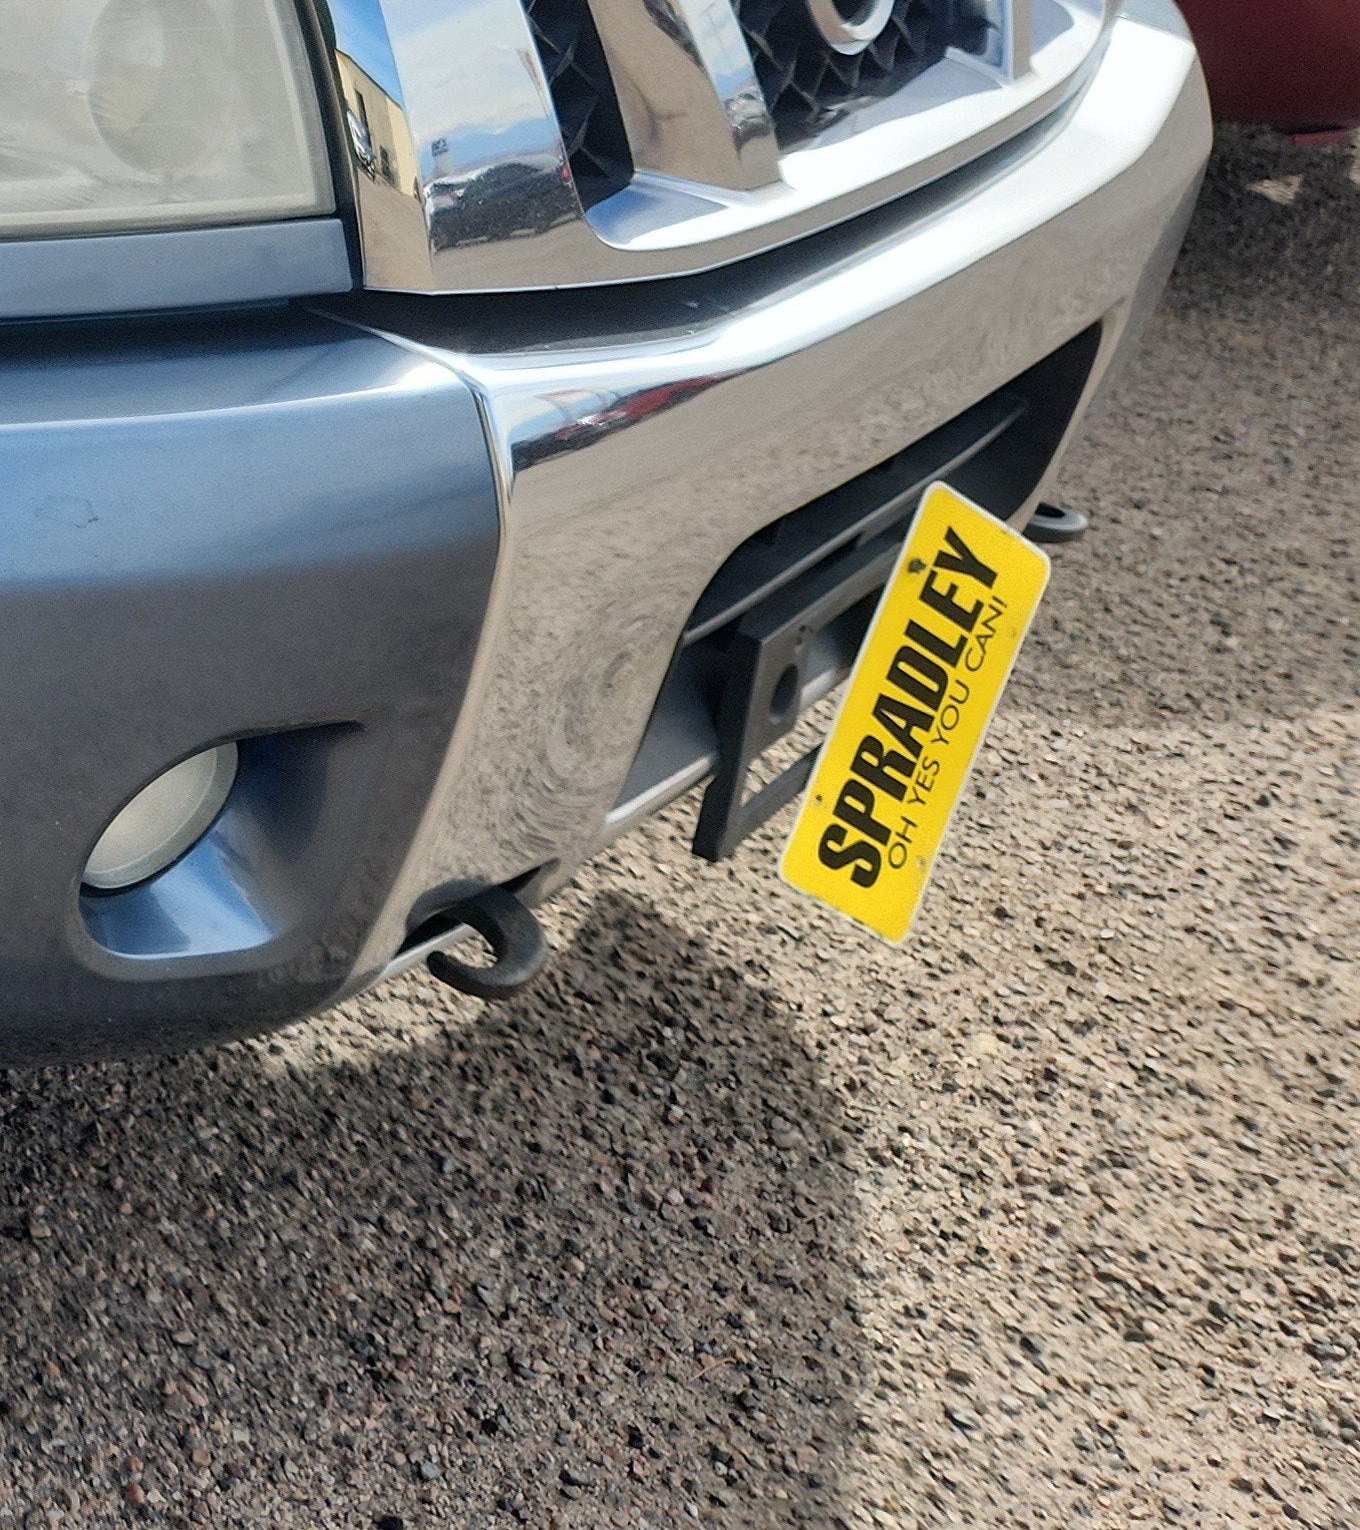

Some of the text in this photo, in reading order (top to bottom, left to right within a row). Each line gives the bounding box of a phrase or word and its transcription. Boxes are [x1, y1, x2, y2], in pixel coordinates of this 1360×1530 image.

[818, 525, 998, 889] SPRADLEY
[887, 595, 1009, 869] OH YES YOU CAN!
